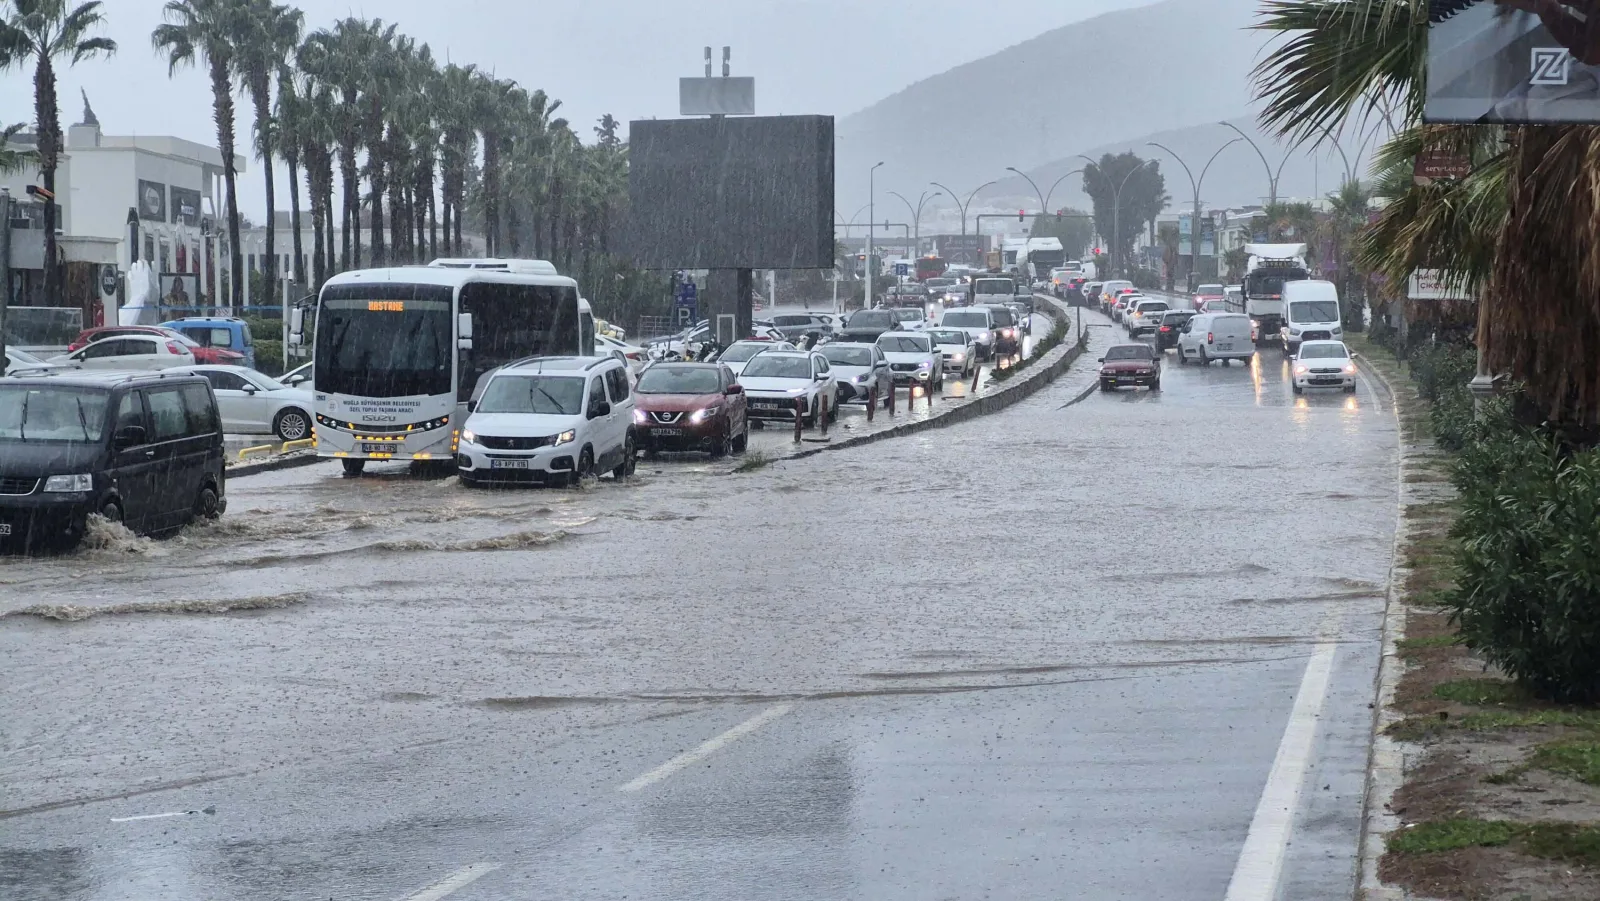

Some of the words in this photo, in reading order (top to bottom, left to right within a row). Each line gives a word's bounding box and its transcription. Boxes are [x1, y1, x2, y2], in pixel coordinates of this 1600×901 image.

[368, 301, 404, 311] HASTANE
[678, 307, 691, 326] P
[362, 414, 396, 422] ISUZU
